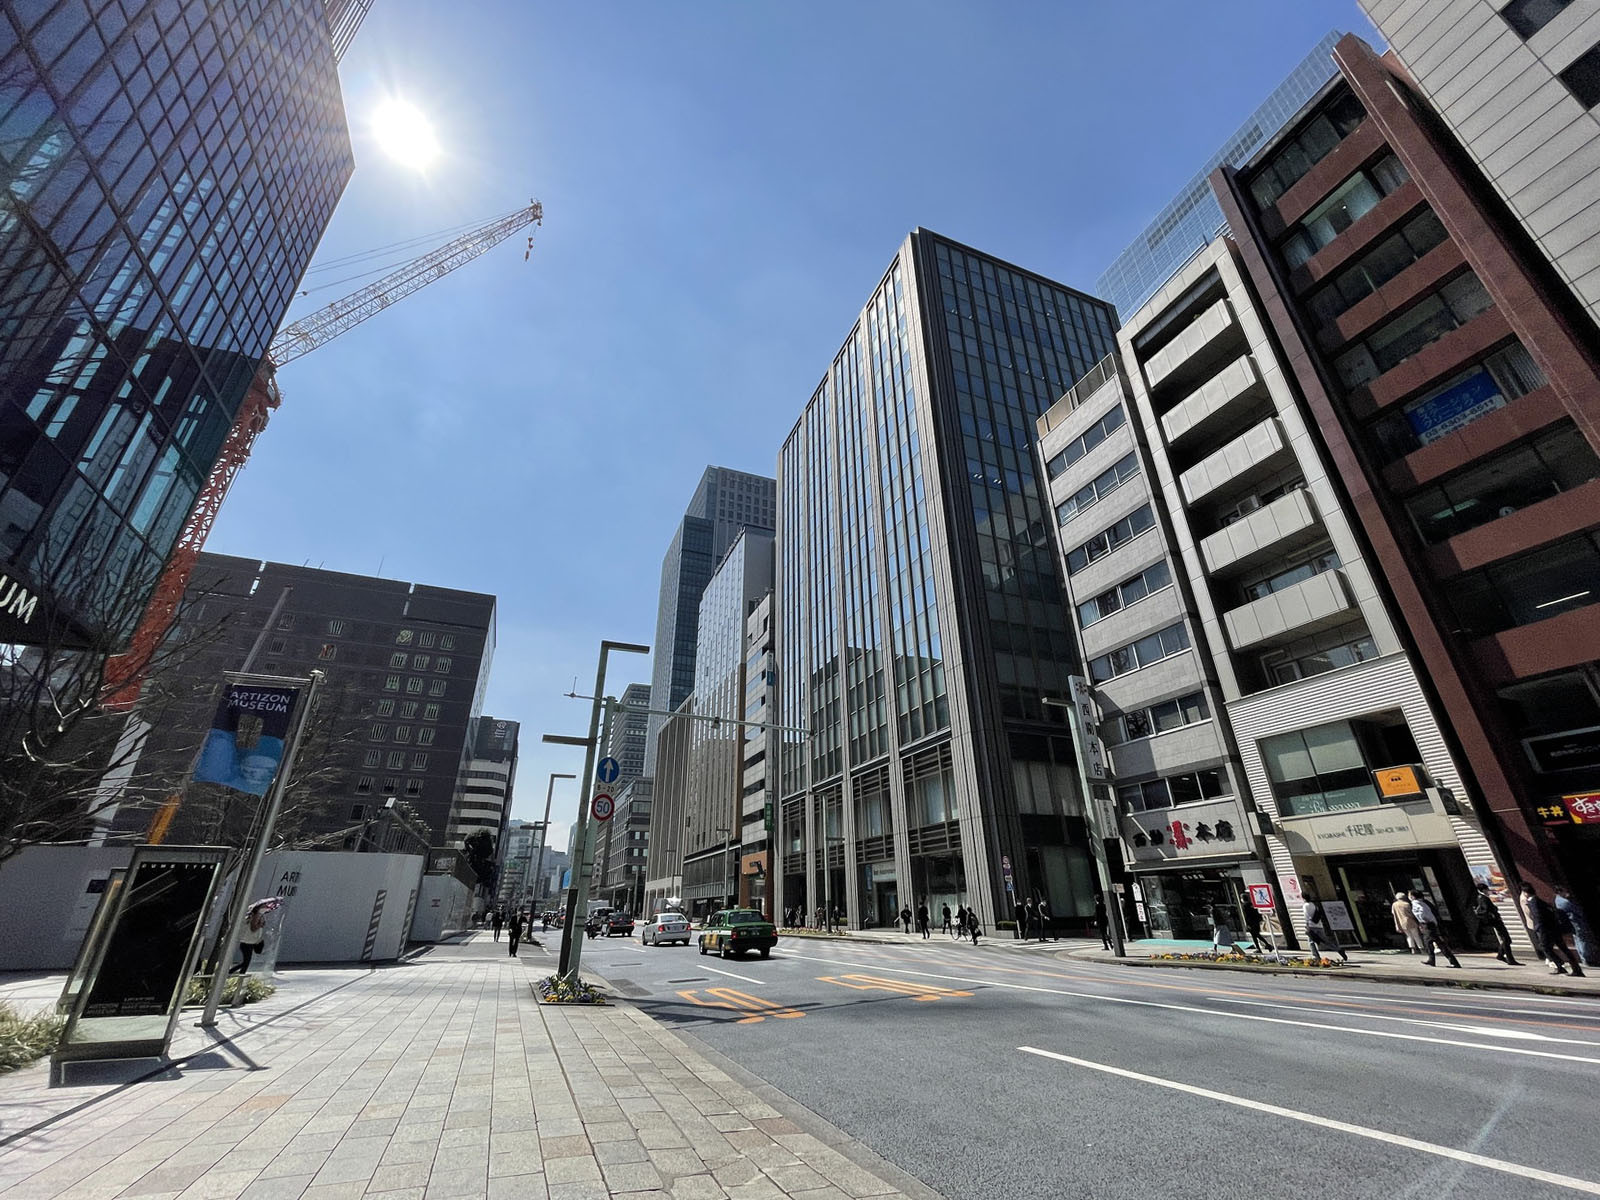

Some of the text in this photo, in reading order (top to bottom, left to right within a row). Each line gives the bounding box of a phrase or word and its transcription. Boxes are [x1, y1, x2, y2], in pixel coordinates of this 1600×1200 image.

[229, 691, 291, 704] ARTIZON
[227, 700, 288, 712] MUSEUM
[596, 801, 610, 814] 50
[1537, 805, 1564, 818] 牛丼
